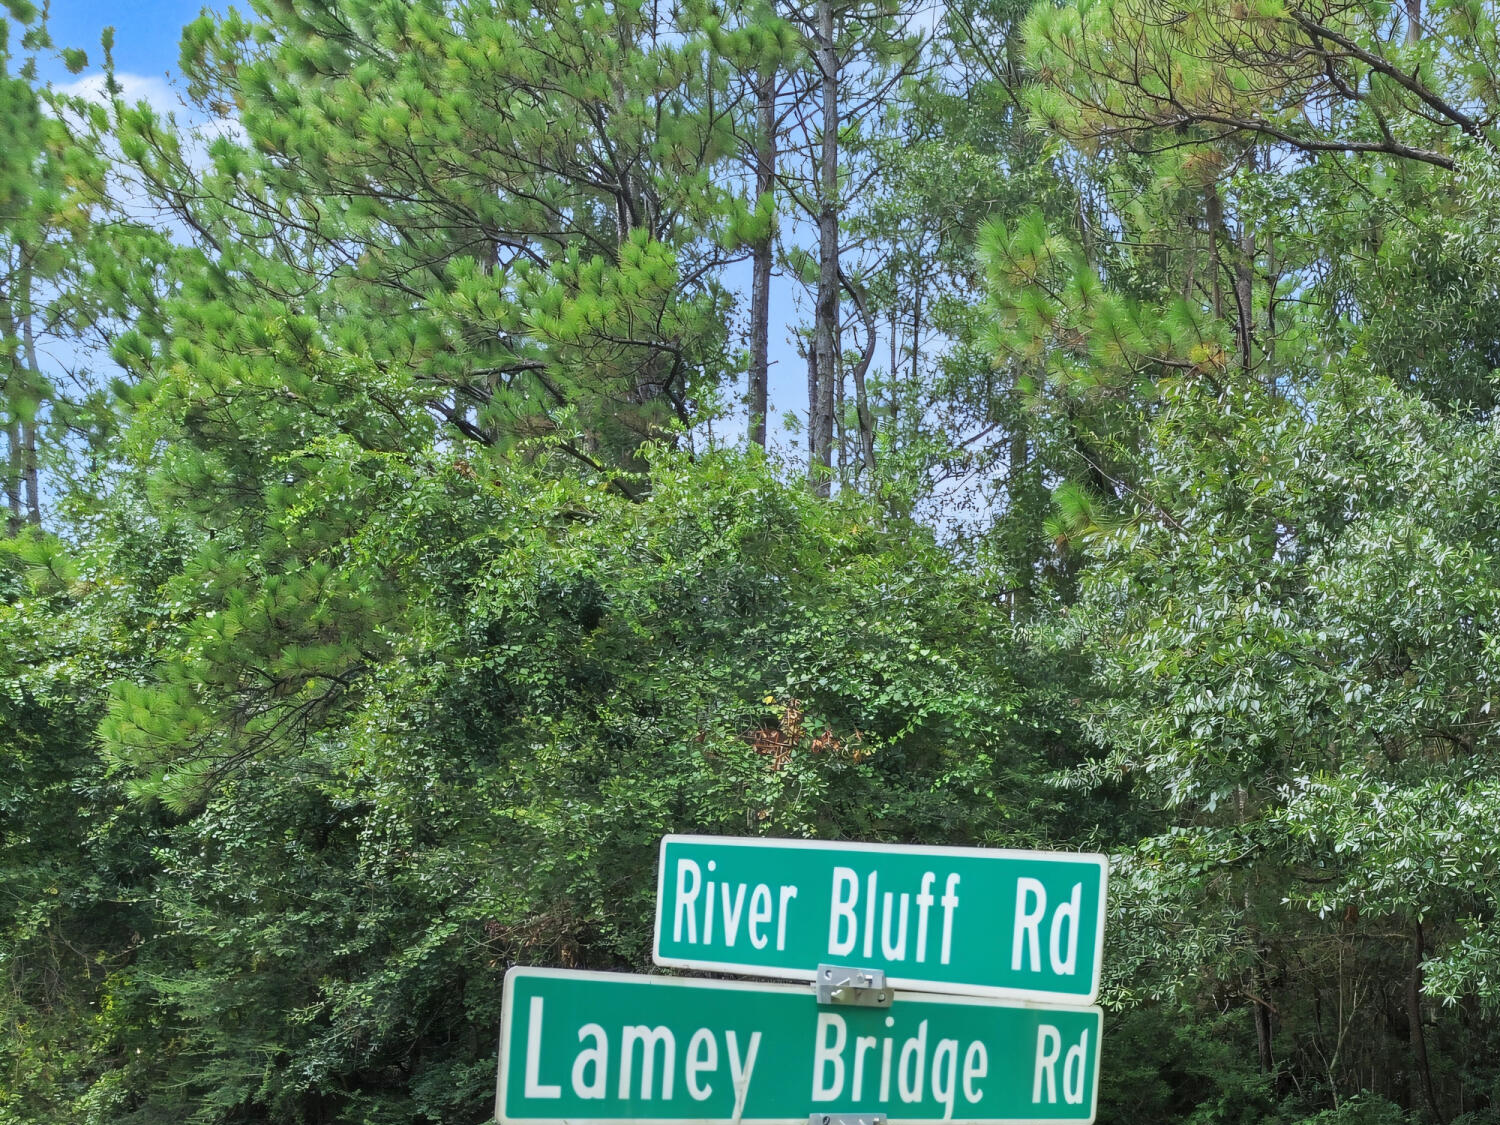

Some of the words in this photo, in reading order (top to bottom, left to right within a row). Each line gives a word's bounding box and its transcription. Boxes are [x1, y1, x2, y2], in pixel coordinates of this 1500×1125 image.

[673, 858, 798, 951] River
[827, 866, 961, 965] Bluff
[1011, 876, 1082, 976] Rd
[523, 996, 763, 1123] Lamey
[811, 1012, 989, 1120] Bridge
[1031, 1024, 1090, 1105] Rd
